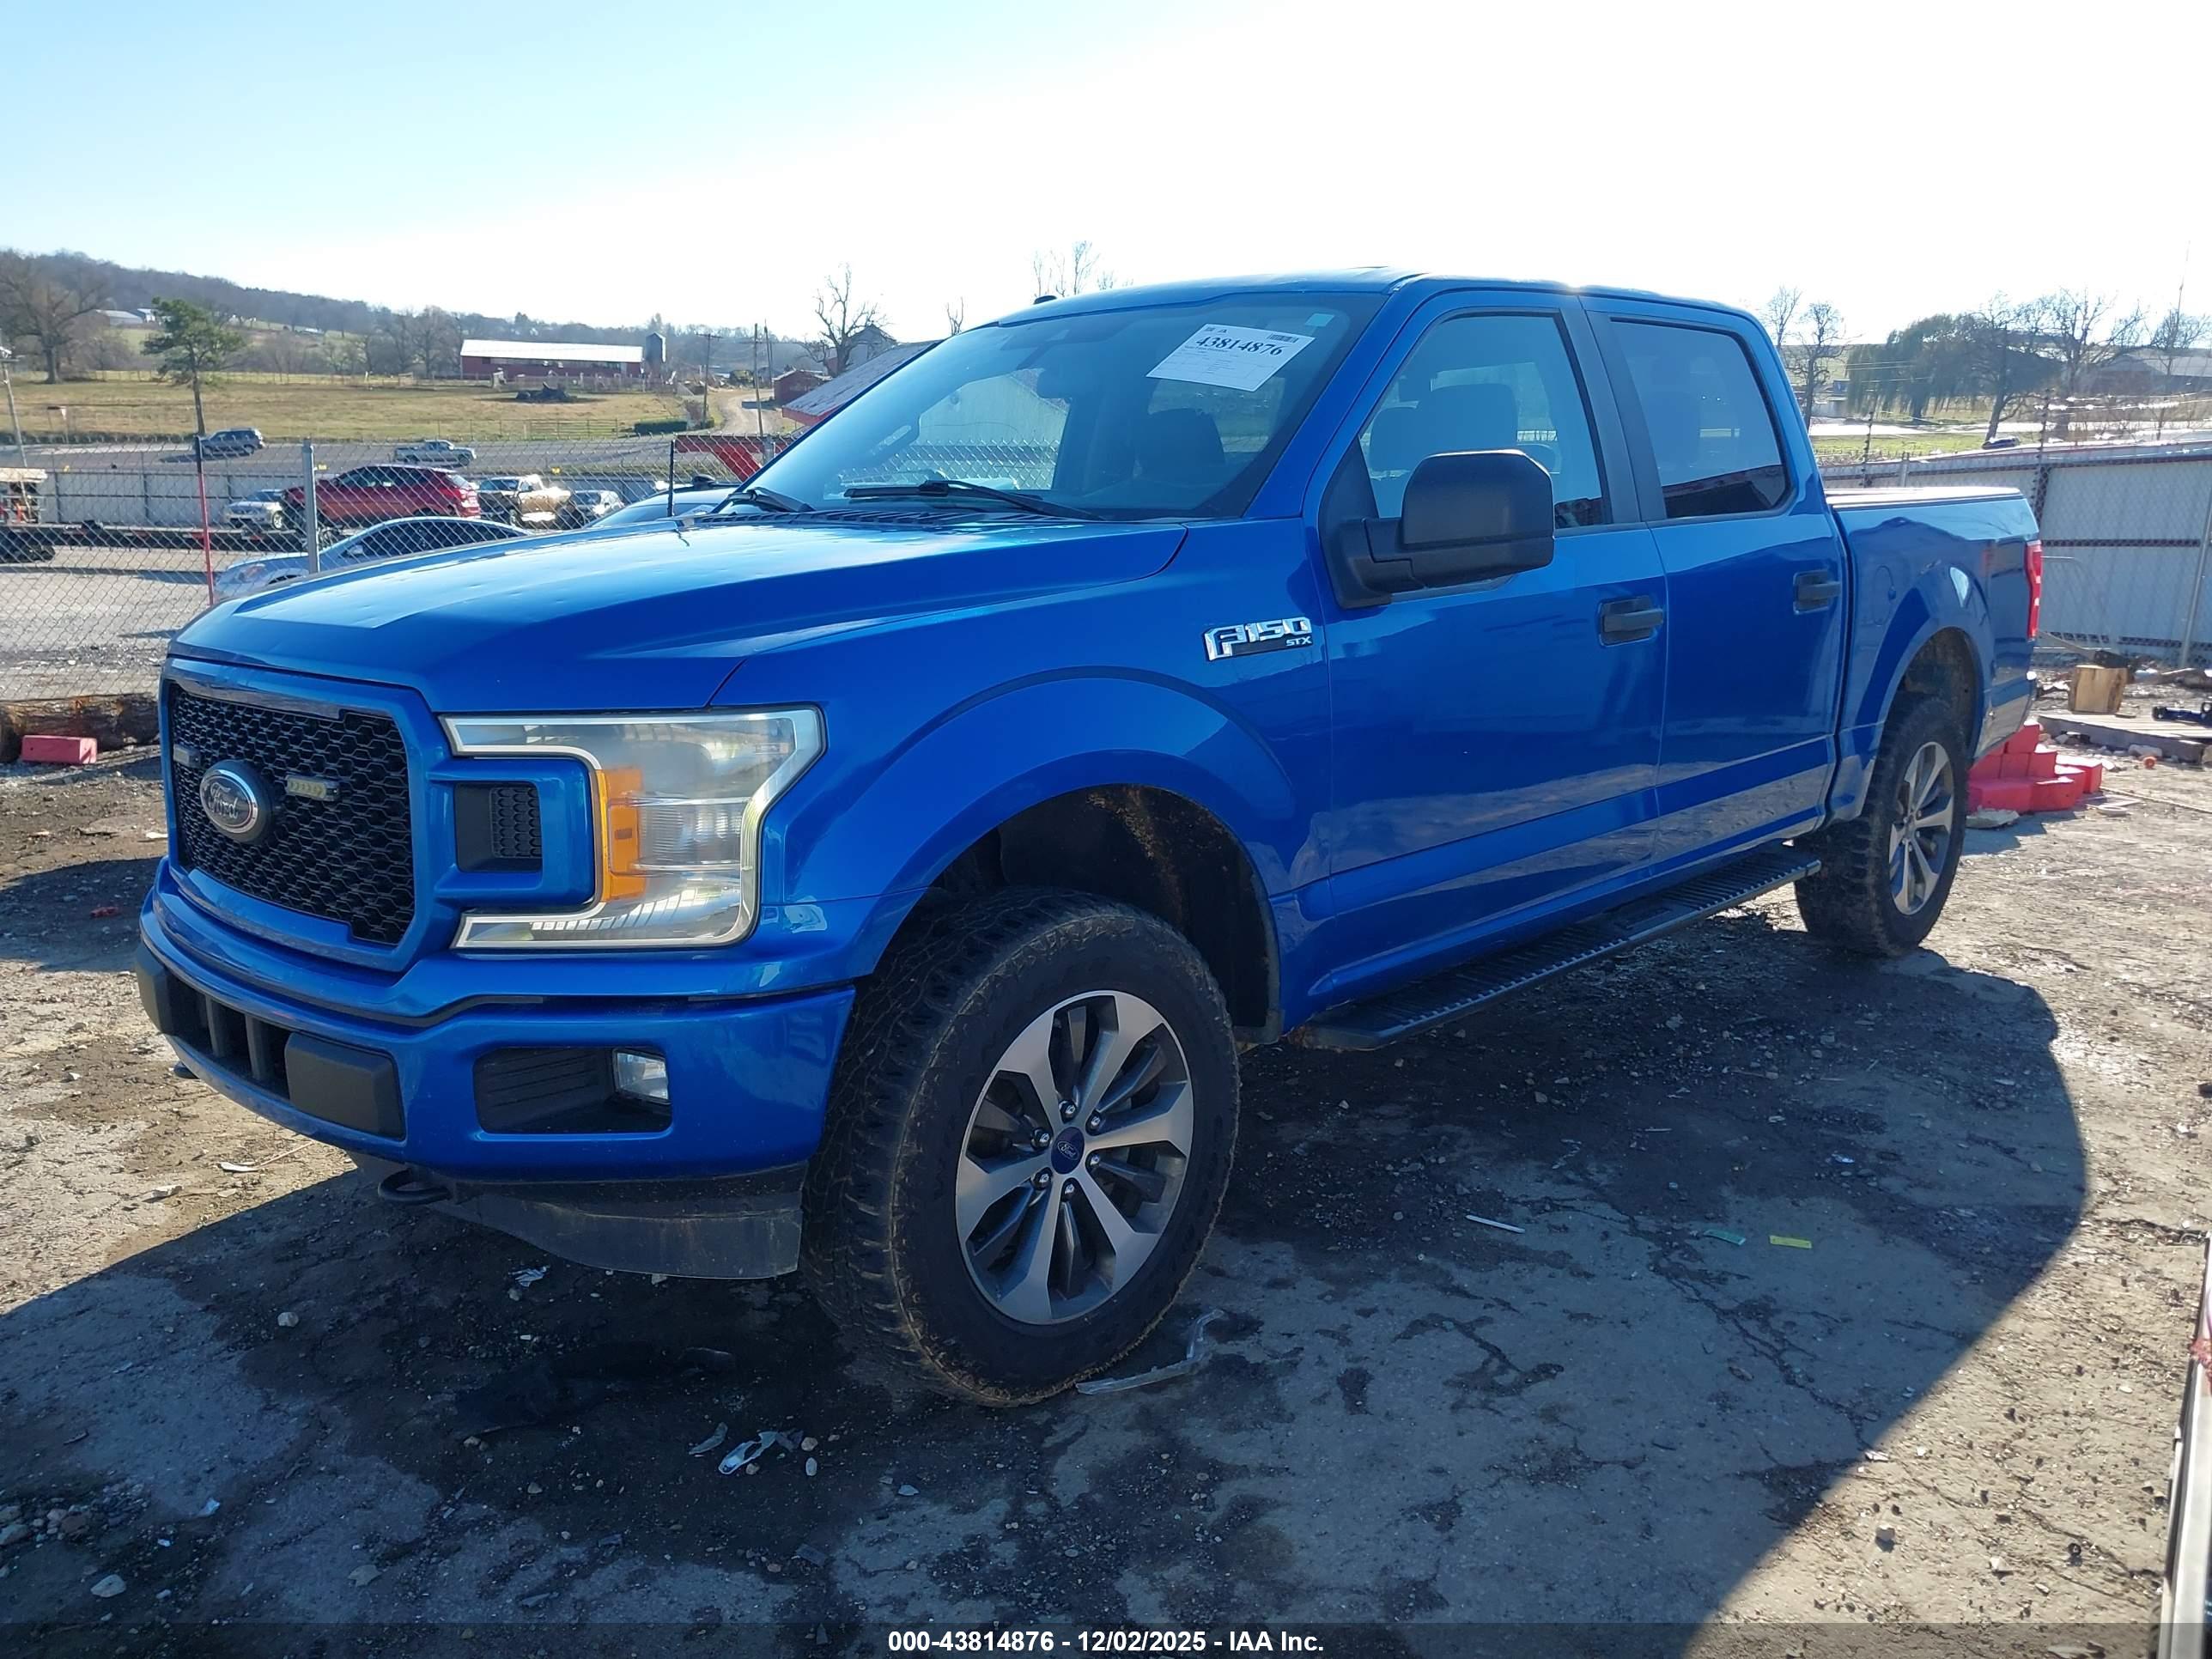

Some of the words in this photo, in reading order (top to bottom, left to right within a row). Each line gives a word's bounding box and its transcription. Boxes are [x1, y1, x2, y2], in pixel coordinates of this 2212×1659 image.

[1195, 336, 1285, 356] 43814876
[1285, 636, 1312, 647] STX
[209, 781, 239, 819] Ford
